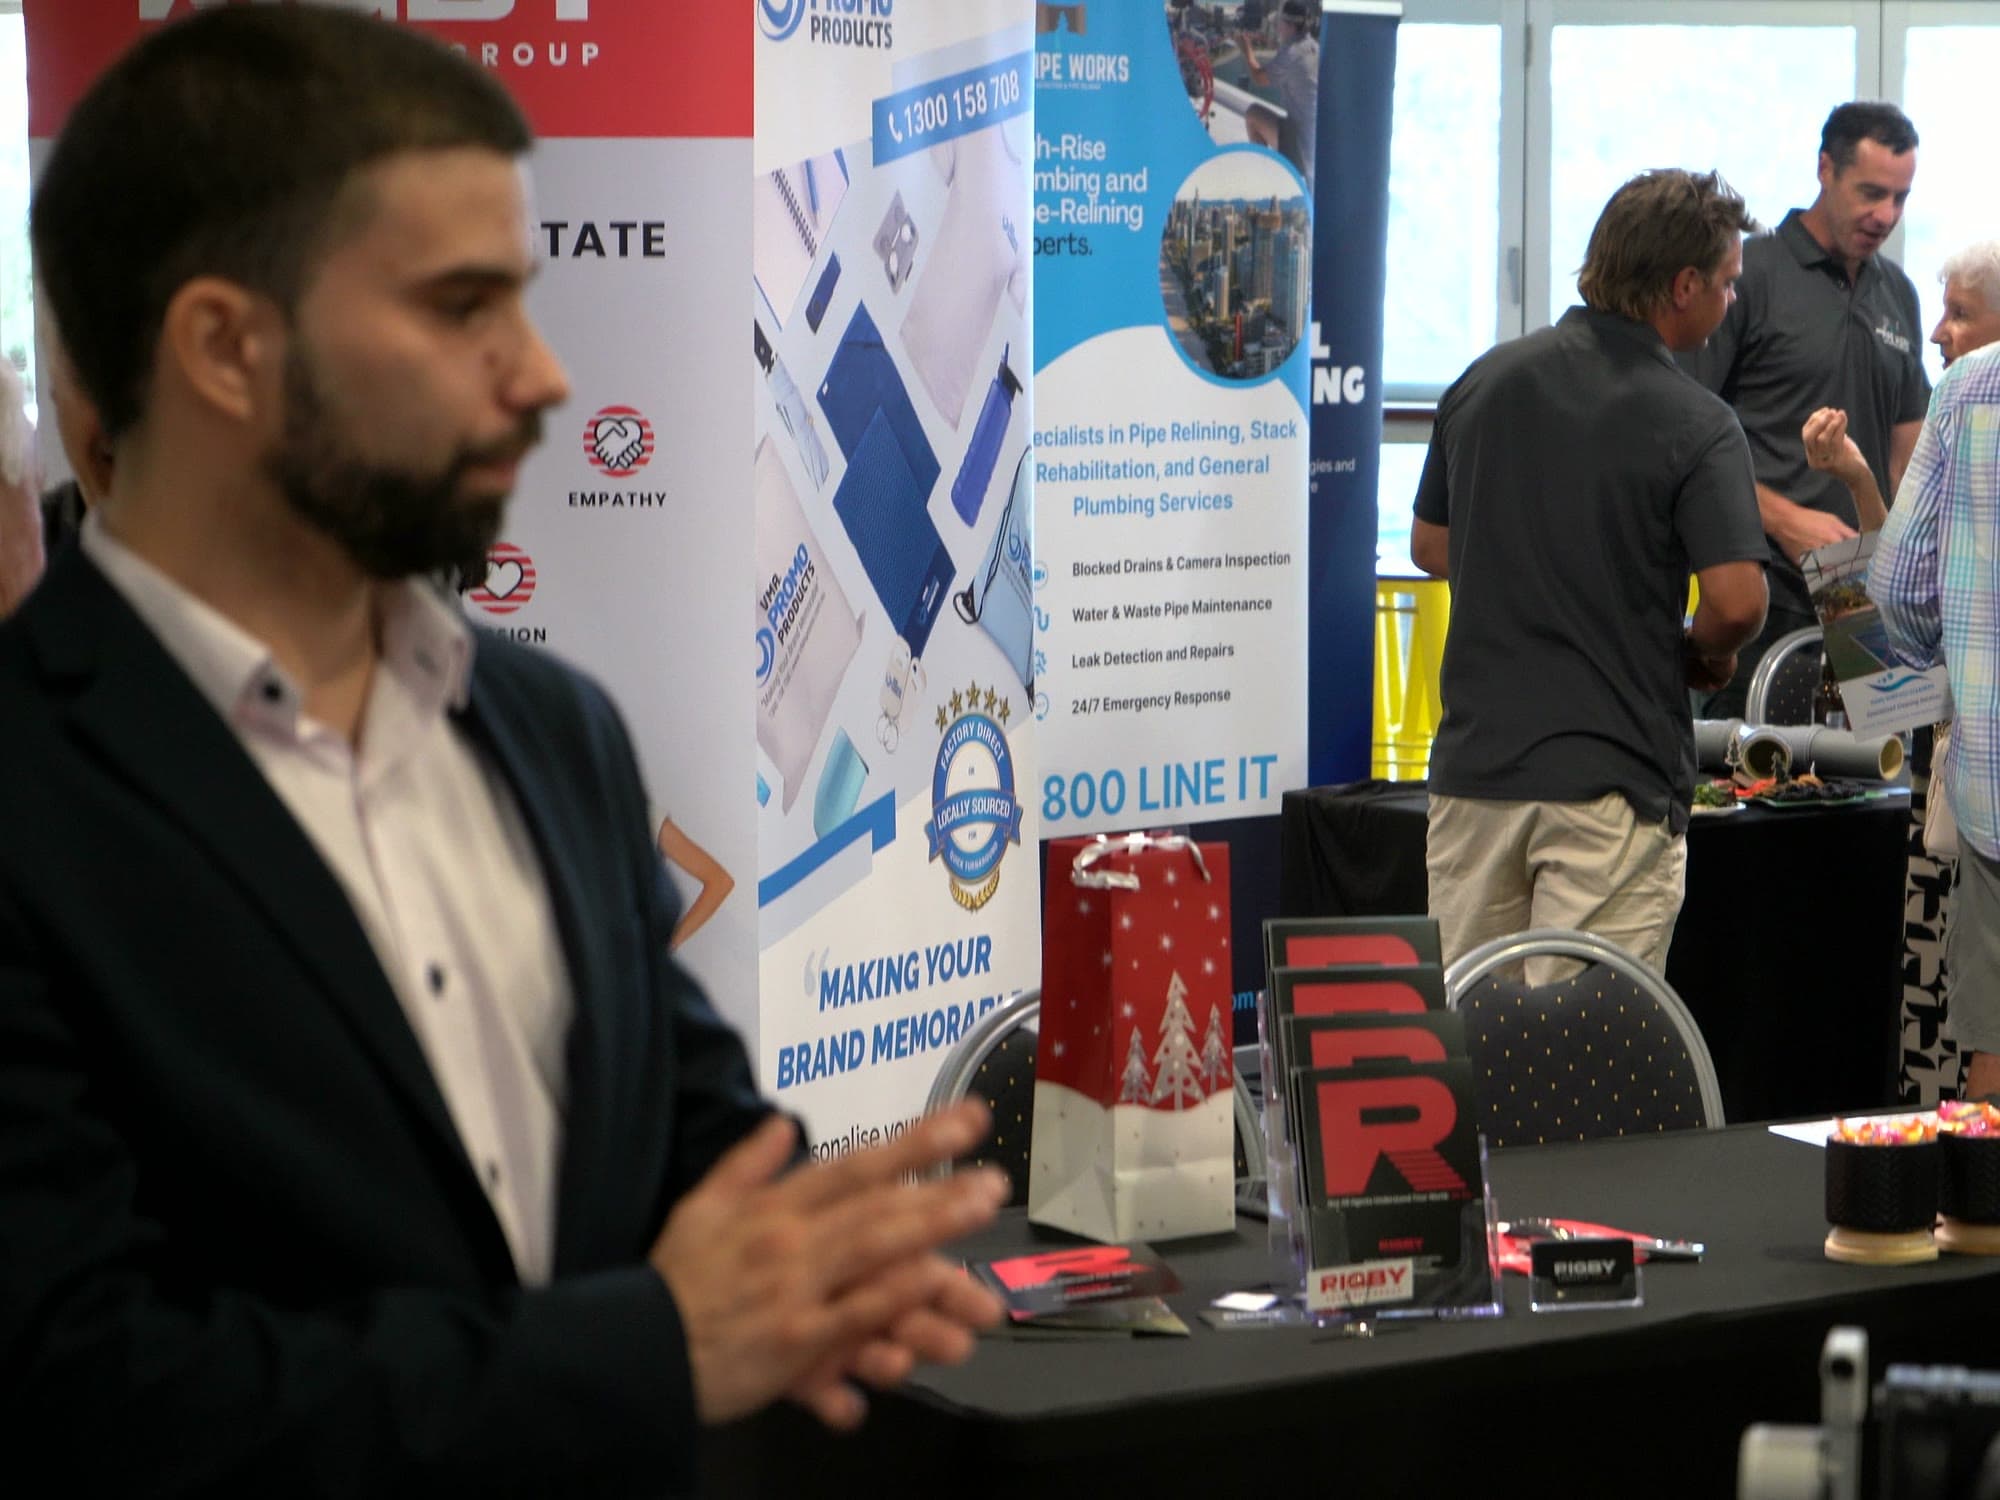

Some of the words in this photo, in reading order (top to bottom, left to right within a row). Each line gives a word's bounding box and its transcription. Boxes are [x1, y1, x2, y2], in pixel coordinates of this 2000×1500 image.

[810, 15, 893, 49] PRODUCTS
[1035, 51, 1062, 80] IPE
[1069, 53, 1130, 83] WORKS
[903, 93, 948, 138] 1300
[953, 82, 988, 122] 158
[990, 69, 1020, 110] 708
[1034, 132, 1106, 160] h-Rise
[1035, 165, 1100, 198] mbing
[1105, 166, 1149, 192] and
[1034, 197, 1143, 231] e-Relining
[539, 221, 666, 258] TATE
[1034, 232, 1093, 256] perts.
[1311, 320, 1331, 359] L
[1312, 365, 1366, 405] NG
[1034, 421, 1104, 447] ecialists
[1108, 423, 1125, 444] in
[1129, 422, 1167, 447] Pipe
[1171, 419, 1246, 445] Relining,
[1250, 418, 1297, 441] Stack
[1036, 459, 1160, 483] Rehabilitation,
[1164, 457, 1195, 477] and
[1199, 454, 1270, 476] General
[1310, 459, 1333, 476] gies
[1335, 458, 1356, 473] and
[568, 491, 667, 508] EMPATHY
[1073, 493, 1154, 519] Plumbing
[1159, 491, 1233, 513] Services
[1072, 561, 1121, 577] Blocked
[1124, 558, 1163, 574] Drains
[1166, 558, 1175, 572] &
[1176, 556, 1222, 571] Camera
[1225, 551, 1291, 571] Inspection
[759, 572, 783, 612] VMR
[767, 542, 810, 632] PROMO
[777, 560, 816, 647] PRODUCTS
[1072, 605, 1109, 623] Water
[1112, 606, 1121, 620] &
[1123, 603, 1162, 619] Waste
[1164, 601, 1190, 620] Pipe
[1192, 597, 1273, 614] Maintenance
[1072, 651, 1101, 669] Leak
[1104, 648, 1163, 667] Detection
[1165, 646, 1187, 662] and
[1190, 642, 1235, 662] Repairs
[1072, 697, 1101, 716] 24/7
[1103, 694, 1171, 713] Emergency
[1174, 688, 1231, 707] Response
[940, 721, 976, 772] FACTORY
[976, 721, 1006, 763] DIRECT
[1139, 758, 1225, 812] LINE
[1238, 753, 1278, 802] IT
[937, 799, 971, 831] LOCALLY
[971, 796, 1011, 820] SOURCED
[925, 934, 992, 987] YOUR
[777, 1028, 865, 1090] BRAND
[871, 988, 1023, 1065] MEMORA
[807, 1122, 881, 1166] sonalise
